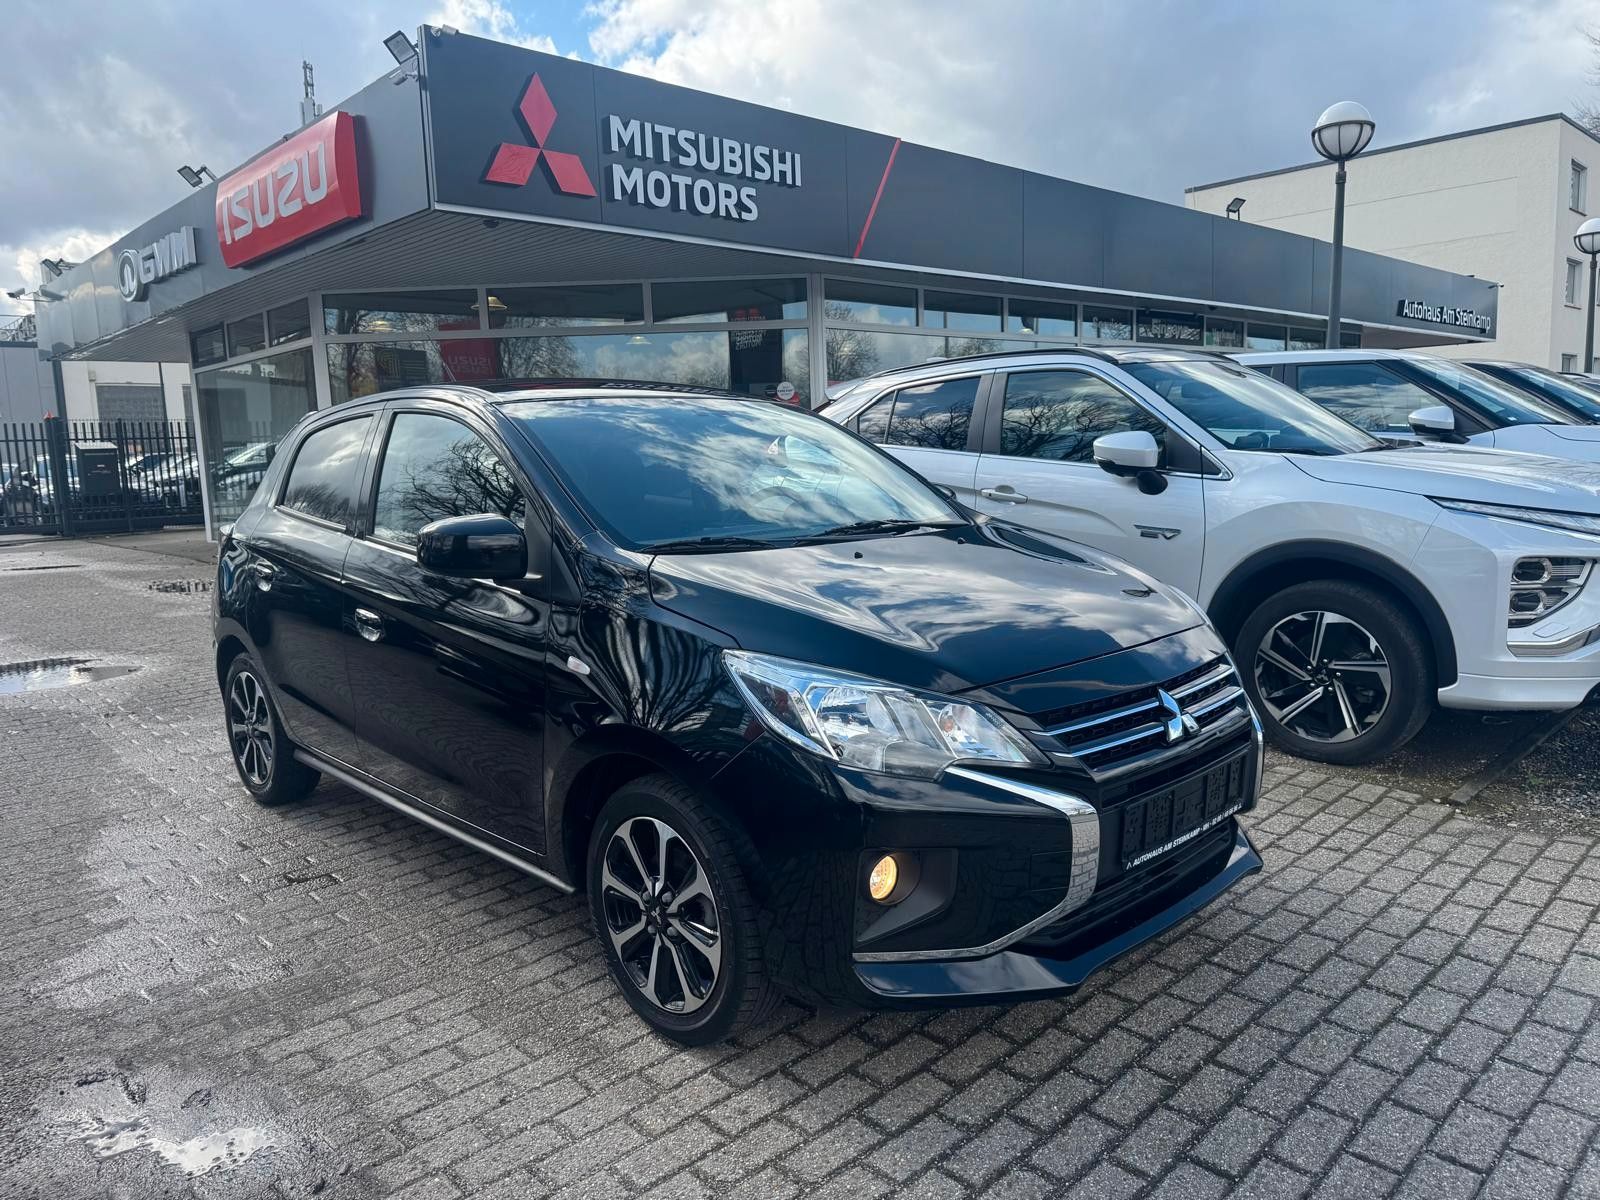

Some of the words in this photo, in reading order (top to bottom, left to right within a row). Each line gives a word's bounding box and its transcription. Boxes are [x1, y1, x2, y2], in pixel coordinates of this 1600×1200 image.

[609, 114, 802, 187] MITSUBISHI
[221, 141, 328, 245] ISUZU
[612, 163, 759, 221] MOTORS
[139, 226, 197, 284] GWM
[1403, 299, 1441, 322] Autohaus
[1442, 306, 1455, 324] Am
[1455, 308, 1491, 334] Steinkamp
[1132, 846, 1163, 867] AUTOHAUS
[1163, 841, 1173, 852] AM
